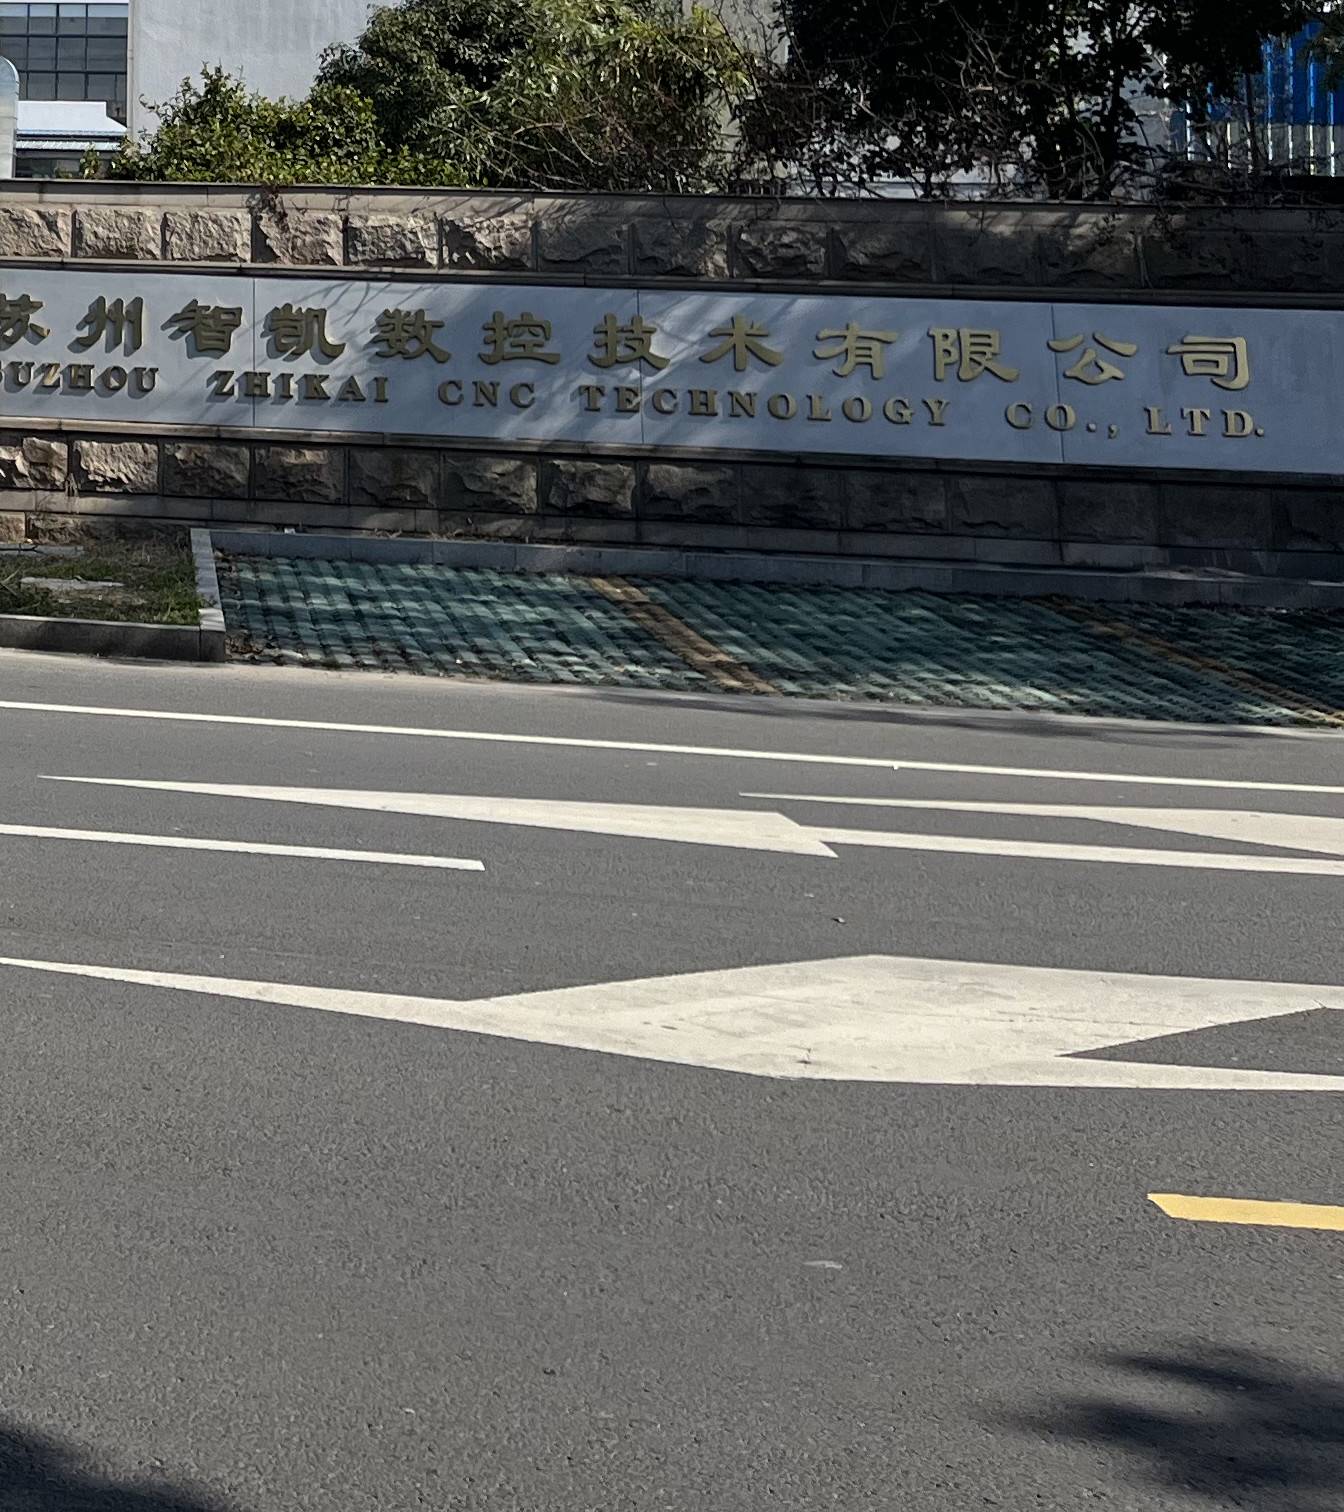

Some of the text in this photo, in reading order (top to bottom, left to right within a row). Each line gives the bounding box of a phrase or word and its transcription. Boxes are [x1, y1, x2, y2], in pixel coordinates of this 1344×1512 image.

[215, 370, 388, 402] ZHIKAI
[437, 380, 536, 409] CNC
[578, 385, 951, 426] TECHNOLOGY
[1005, 402, 1119, 439] CO.,
[1145, 407, 1265, 437] LTD.
